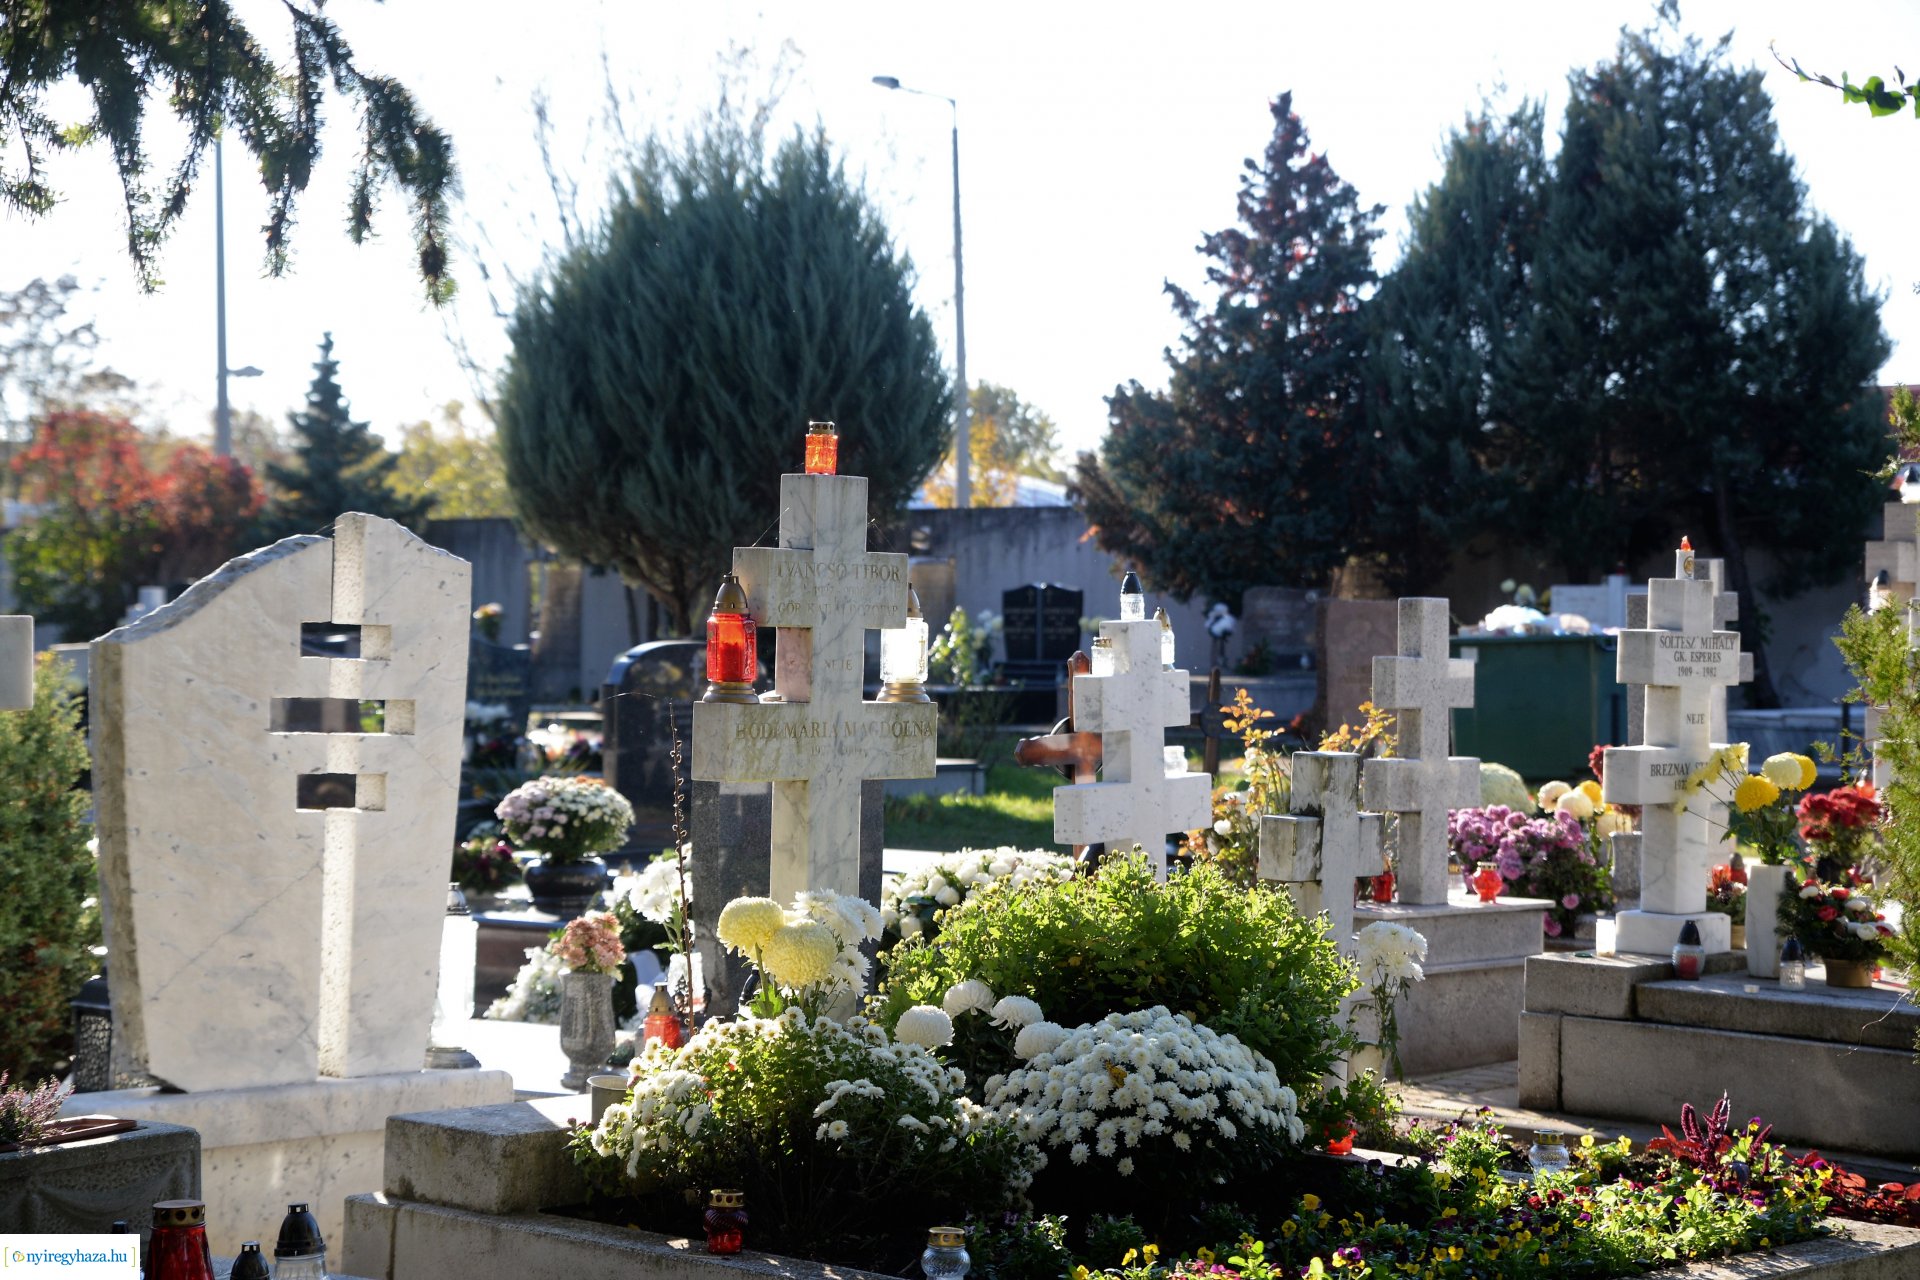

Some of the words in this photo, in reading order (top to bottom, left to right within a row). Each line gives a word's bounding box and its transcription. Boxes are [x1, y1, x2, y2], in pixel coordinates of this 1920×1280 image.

[851, 563, 900, 582] TIBOR
[1678, 666, 1693, 678] 1909
[1686, 713, 1705, 725] NEJE
